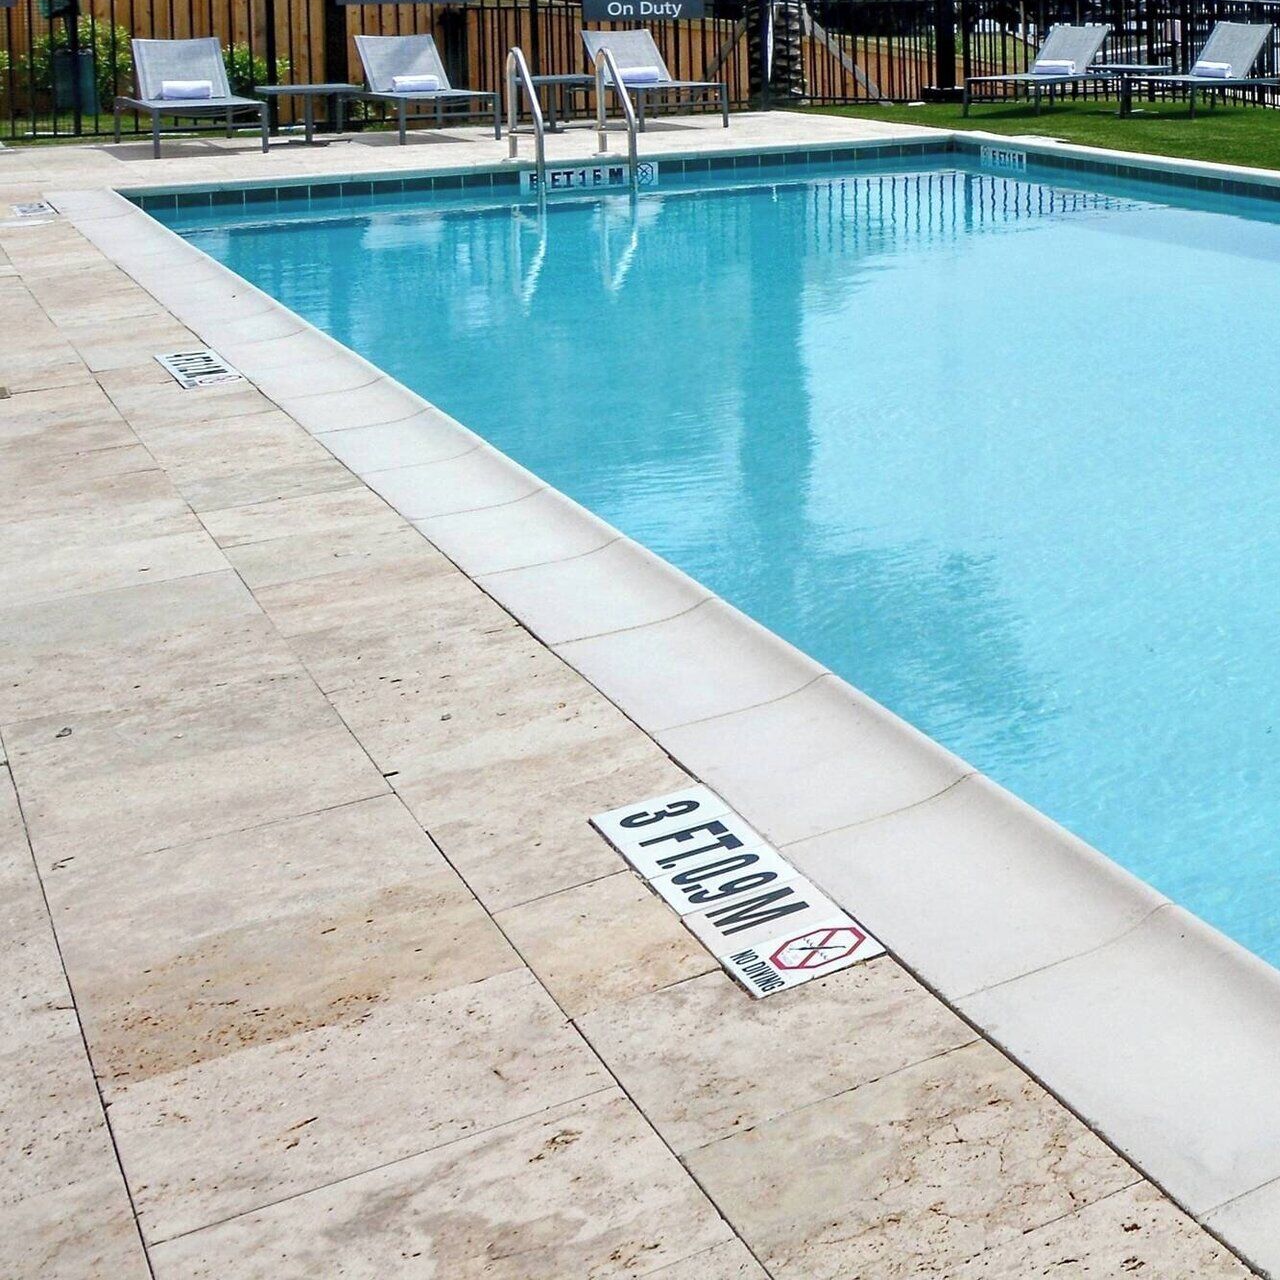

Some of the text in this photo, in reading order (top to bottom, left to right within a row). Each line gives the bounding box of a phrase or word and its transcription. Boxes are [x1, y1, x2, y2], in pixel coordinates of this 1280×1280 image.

[607, 1, 682, 18] On Duty
[619, 800, 700, 829] 3
[730, 949, 785, 993] NO DIVING
